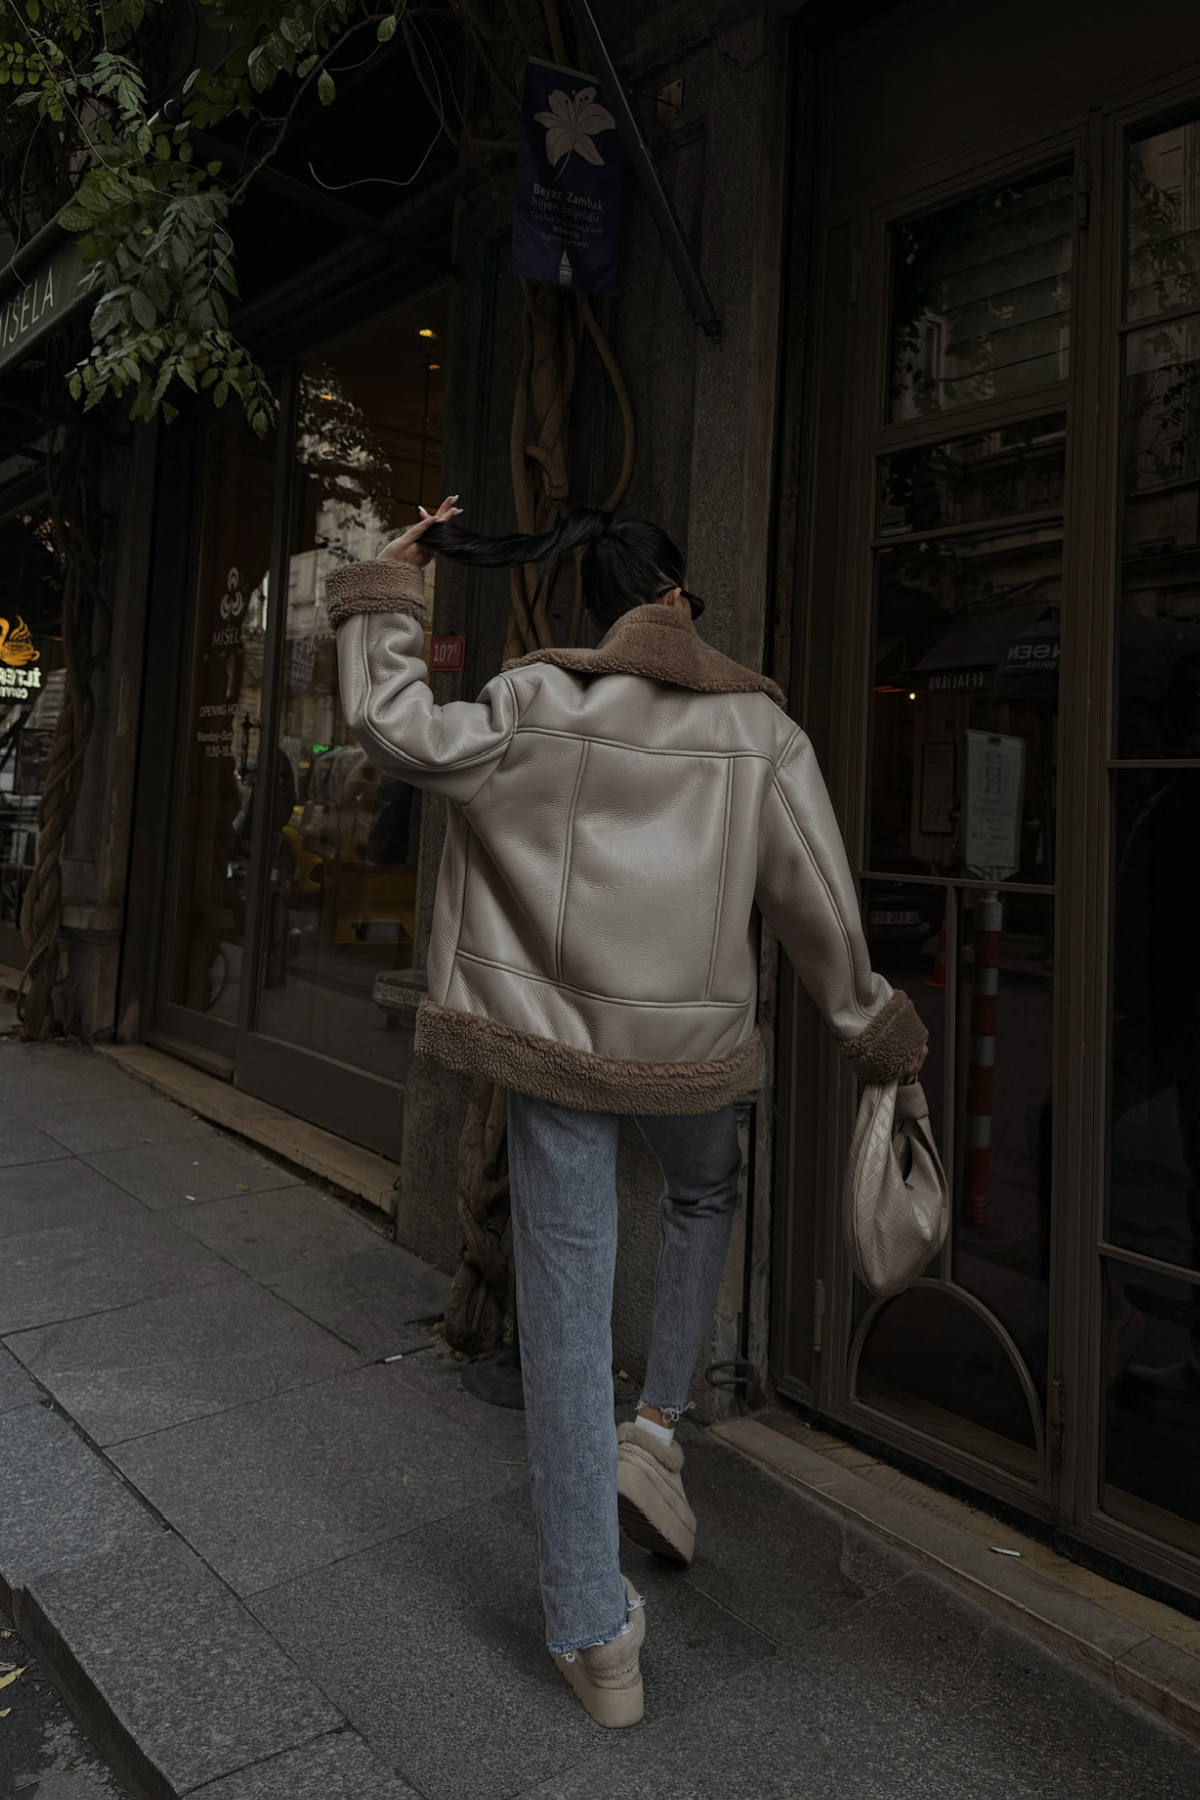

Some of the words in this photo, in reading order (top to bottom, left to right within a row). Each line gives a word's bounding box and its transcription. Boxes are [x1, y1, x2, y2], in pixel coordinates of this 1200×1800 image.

[532, 196, 559, 212] hijyen
[533, 183, 562, 199] Beyaz
[566, 191, 603, 211] Zambak
[199, 704, 227, 717] OPENING
